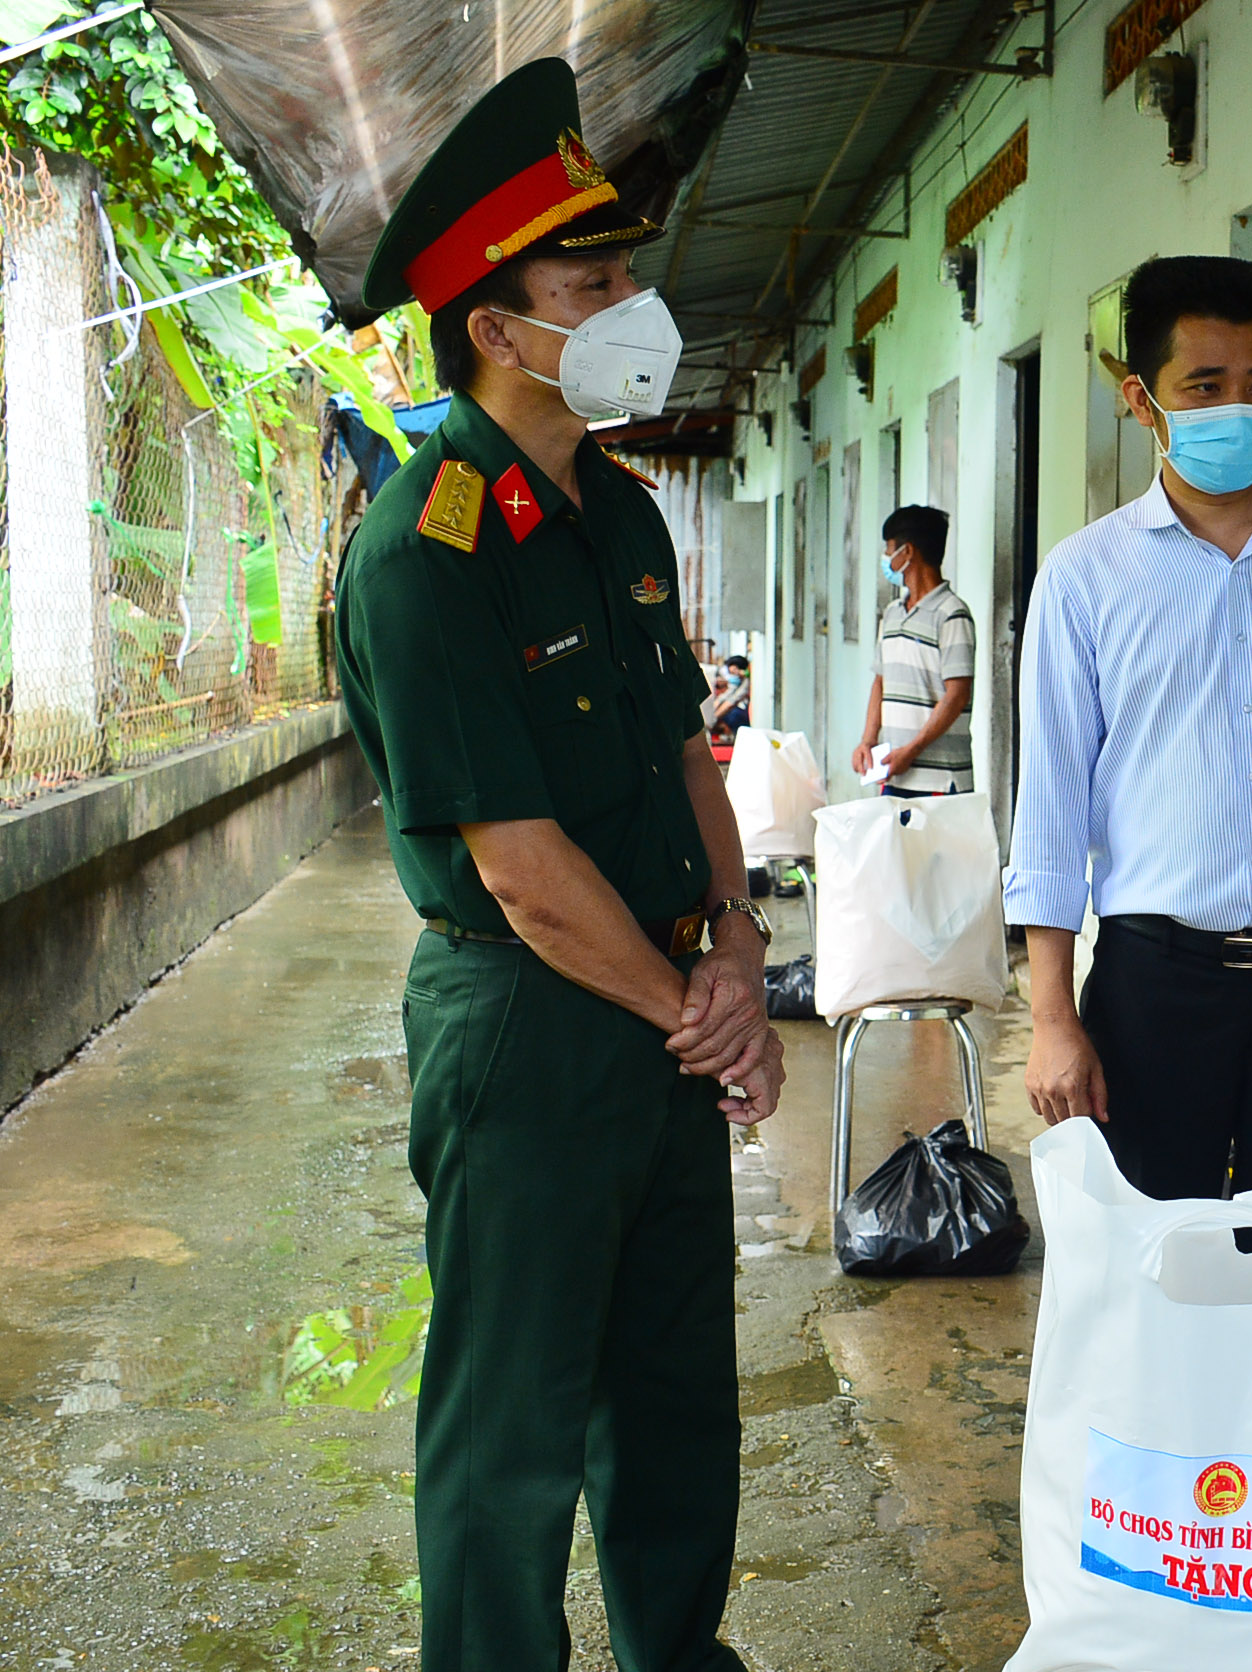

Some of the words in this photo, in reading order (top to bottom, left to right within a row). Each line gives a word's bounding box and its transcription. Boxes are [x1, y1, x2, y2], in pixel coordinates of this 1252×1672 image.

[636, 374, 651, 384] 3M
[1090, 1497, 1115, 1529] BỘ
[1119, 1510, 1174, 1542] CHQS
[1179, 1521, 1225, 1550] TỈNH
